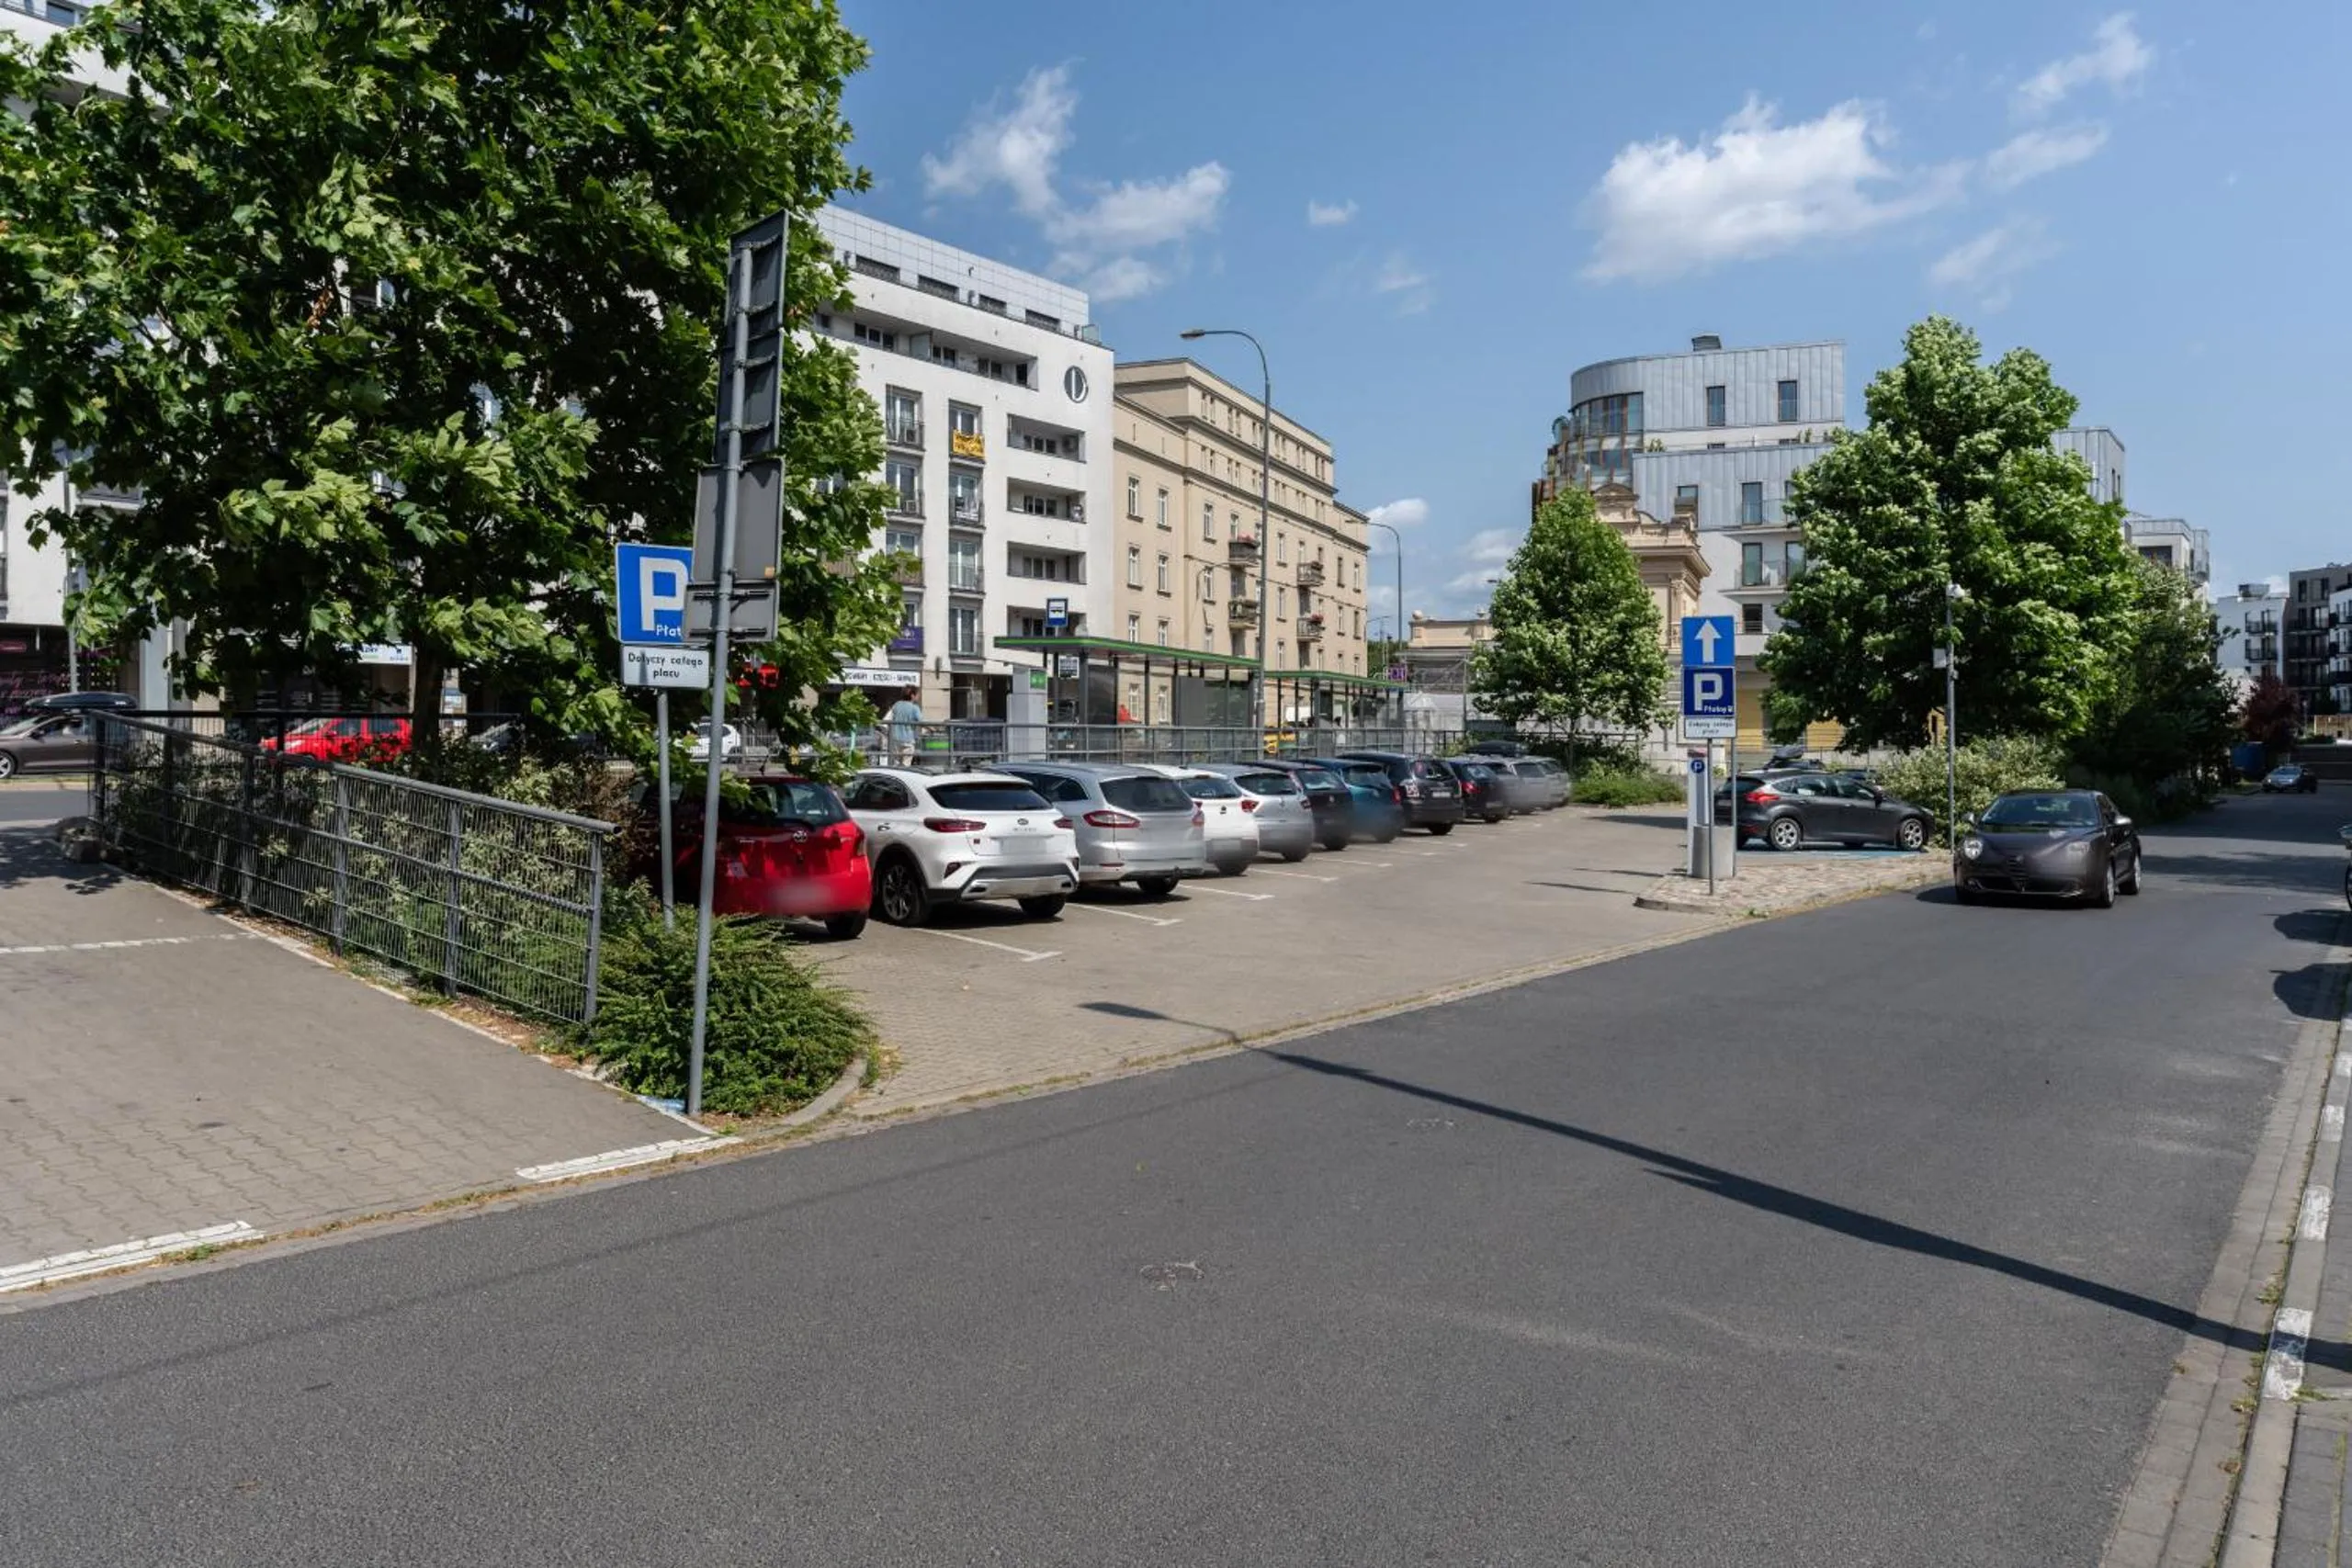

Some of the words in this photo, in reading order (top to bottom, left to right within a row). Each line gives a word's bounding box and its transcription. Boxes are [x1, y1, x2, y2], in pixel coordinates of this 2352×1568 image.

[639, 557, 688, 631] P
[656, 625, 682, 637] Płat
[628, 652, 665, 666] Dotyczy
[671, 657, 703, 668] całego
[653, 669, 680, 679] placu
[1693, 672, 1723, 711] P
[1694, 761, 1702, 773] P
